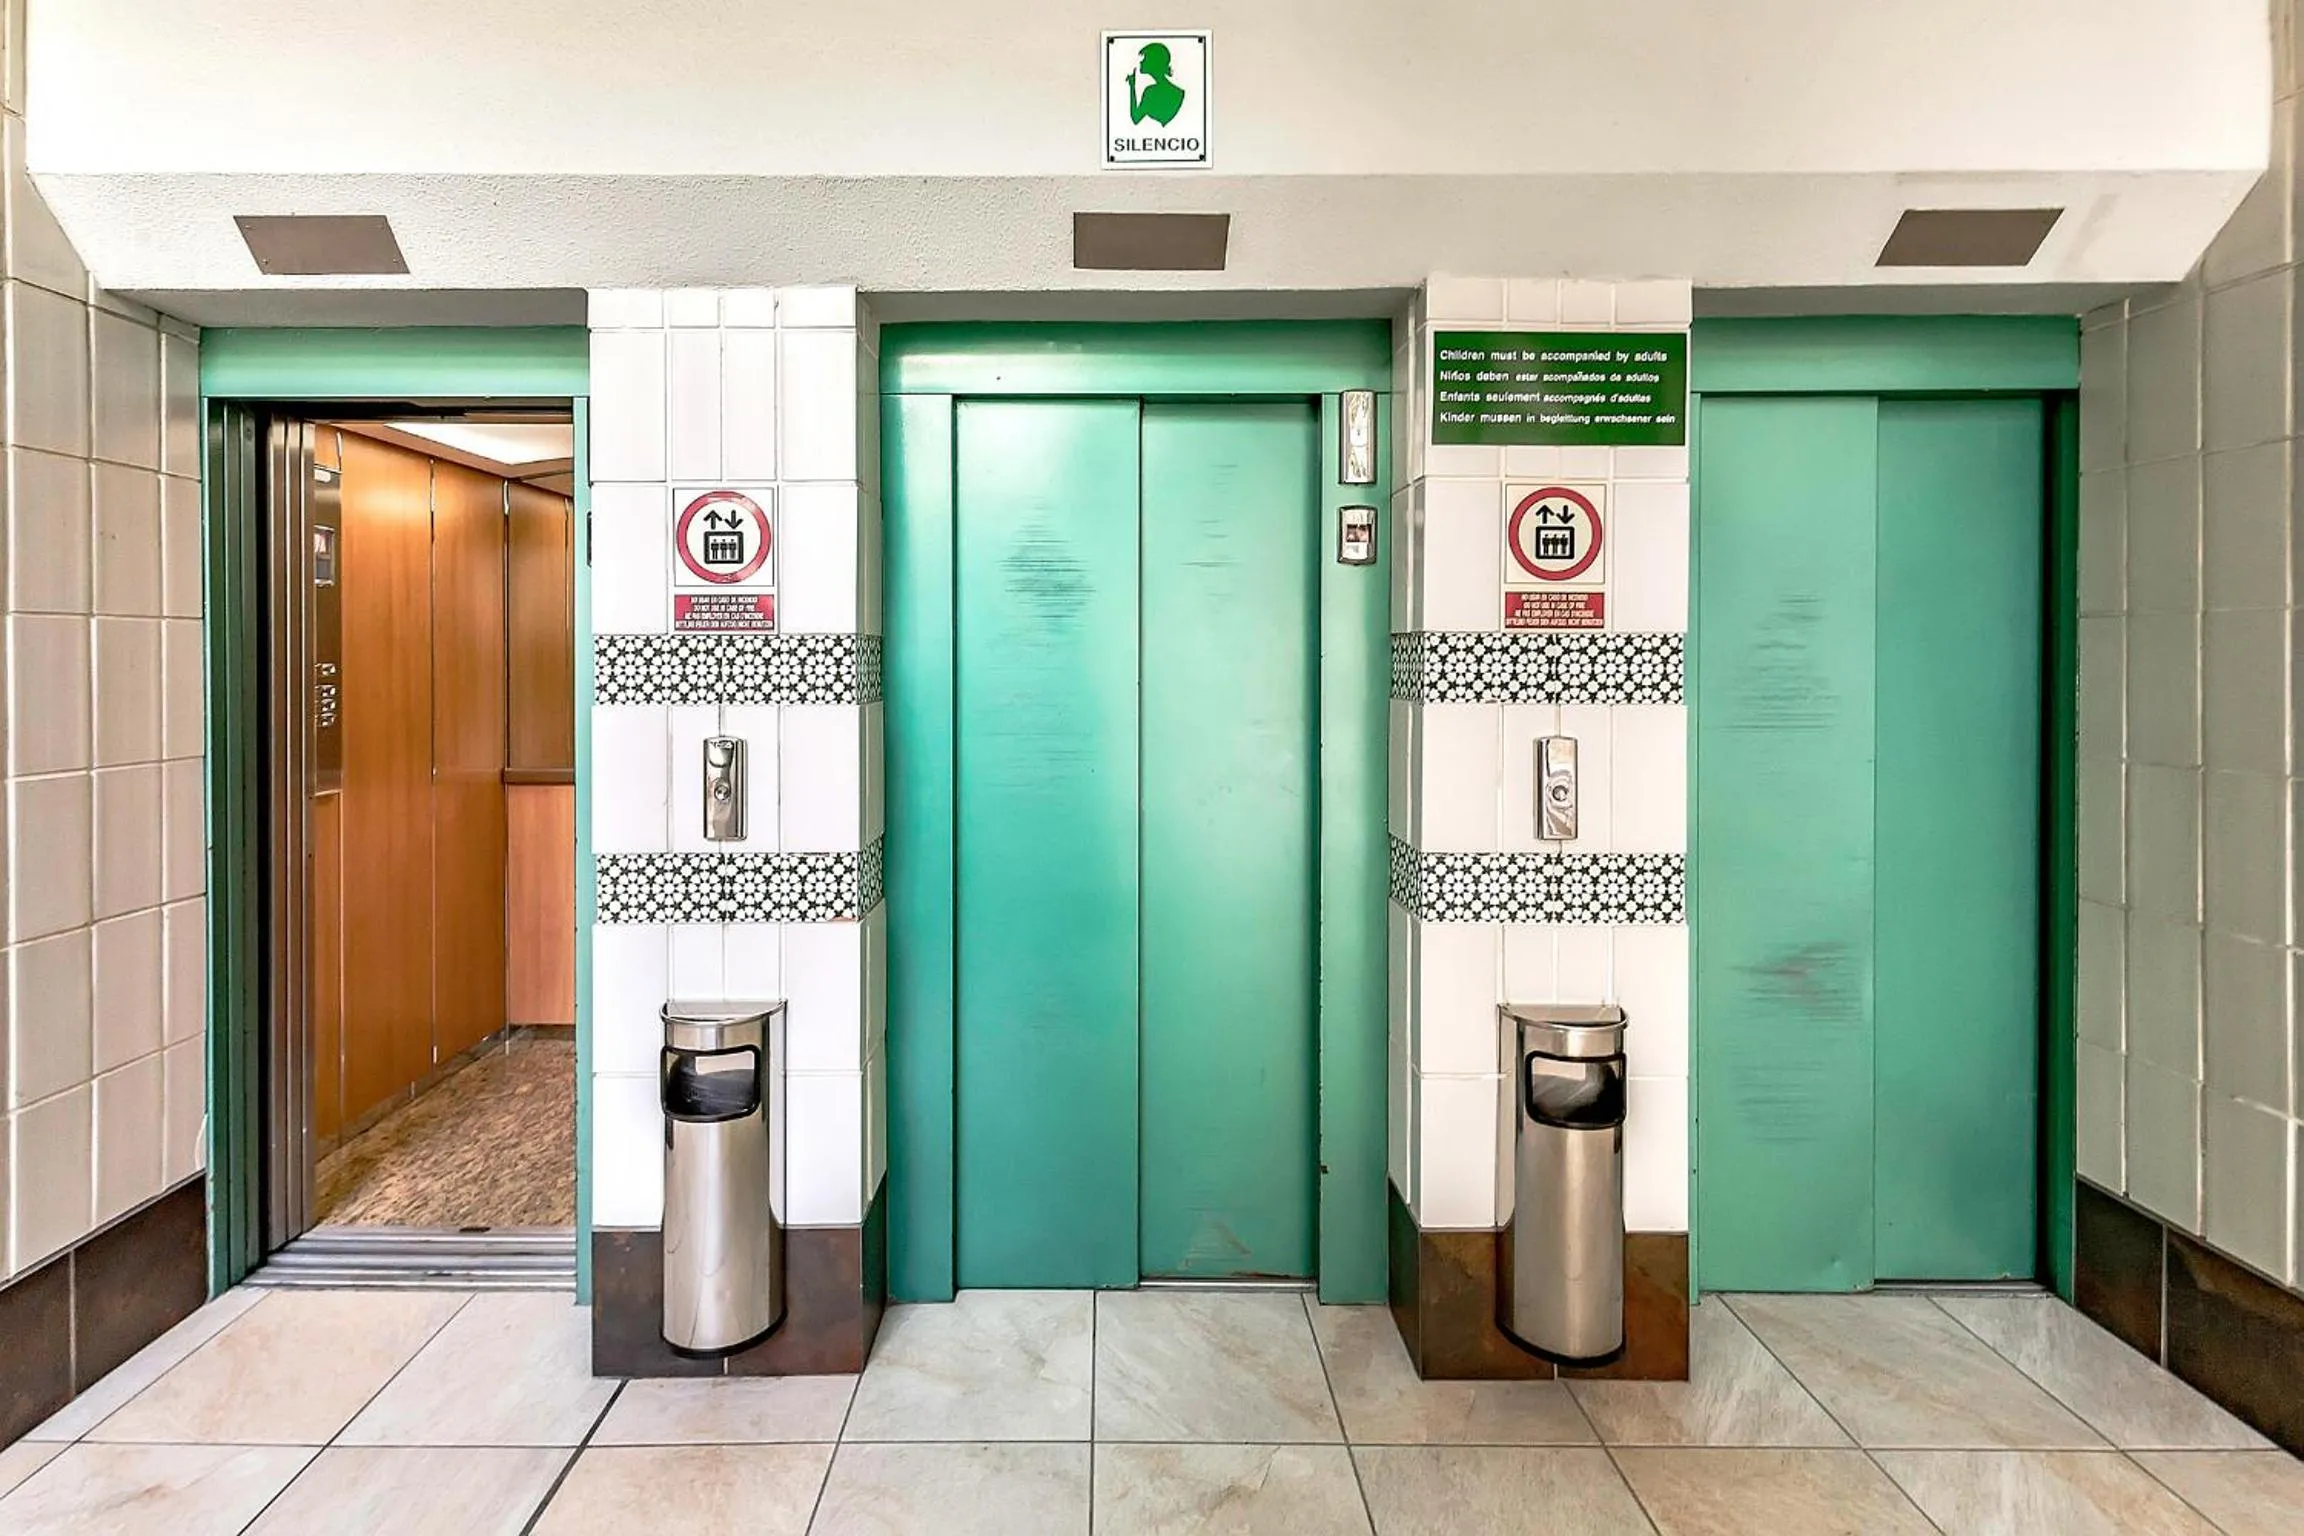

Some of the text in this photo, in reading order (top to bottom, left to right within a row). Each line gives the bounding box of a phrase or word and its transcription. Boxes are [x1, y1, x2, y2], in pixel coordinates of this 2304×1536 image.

[1113, 137, 1200, 152] SILENCIO
[1439, 349, 1668, 364] Children must be accompanied by adults
[1439, 370, 1660, 384] Niños deben estar acompañados de adultos
[1439, 390, 1481, 402] Enfants
[1486, 390, 1541, 403] seulement
[1439, 411, 1476, 423] Kinder
[1526, 412, 1536, 423] in
[1655, 413, 1676, 424] sein
